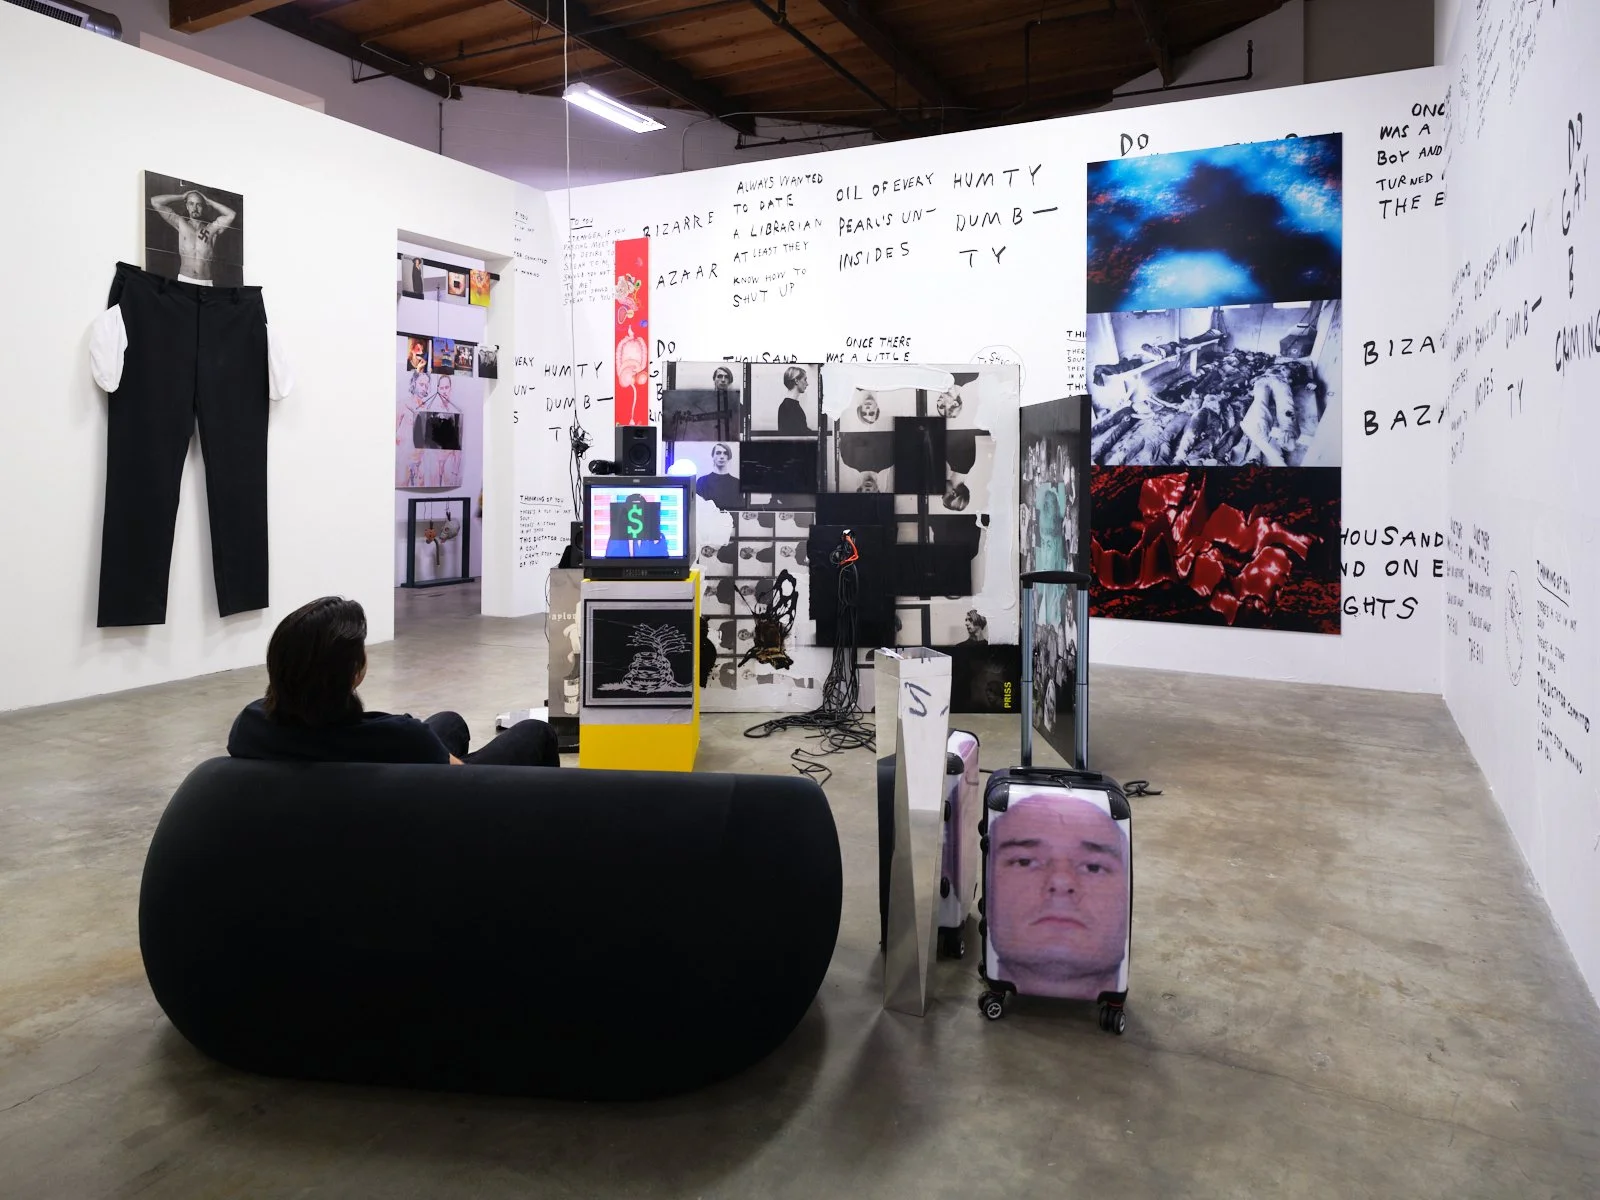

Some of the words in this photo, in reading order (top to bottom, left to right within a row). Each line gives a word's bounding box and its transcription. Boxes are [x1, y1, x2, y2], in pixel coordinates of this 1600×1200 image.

[1411, 103, 1445, 117] ONC
[1380, 125, 1409, 139] WAS
[1417, 122, 1430, 136] A
[1120, 133, 1150, 157] DO
[1568, 112, 1583, 175] DO
[1377, 149, 1409, 166] BOY
[1418, 144, 1443, 159] AND
[736, 176, 775, 195] ALWAYS
[780, 172, 825, 188] WANTED
[836, 185, 863, 202] OIL
[893, 172, 935, 192] EVERY
[953, 164, 1042, 189] HUMTY
[1375, 172, 1434, 191] TURNED
[733, 203, 749, 214] TO
[760, 194, 793, 212] DATE
[1378, 194, 1421, 219] THE
[1433, 191, 1445, 206] E
[733, 228, 740, 239] A
[750, 219, 823, 238] LIBRARIAN
[838, 214, 893, 237] PEARL'S
[733, 252, 749, 263] AT
[752, 246, 778, 259] LEAST
[782, 242, 809, 253] THEY
[839, 242, 910, 272] INSIDES
[959, 246, 1007, 268] TY
[656, 263, 718, 290] AZAAR
[733, 275, 760, 285] KNOW
[765, 272, 786, 282] HOW
[795, 267, 806, 276] TO
[733, 290, 768, 308] SHUT
[780, 282, 795, 298] UP
[657, 340, 676, 358] DO
[846, 336, 874, 349] ONCE
[879, 336, 912, 348] THERE
[1363, 336, 1436, 366] BIZA
[514, 356, 535, 368] VERY
[826, 352, 846, 363] WAS
[852, 352, 858, 363] A
[866, 352, 910, 364] LITTLE
[514, 411, 520, 424] S
[1340, 526, 1444, 548] HOUSAND
[1343, 596, 1418, 619] GHTS
